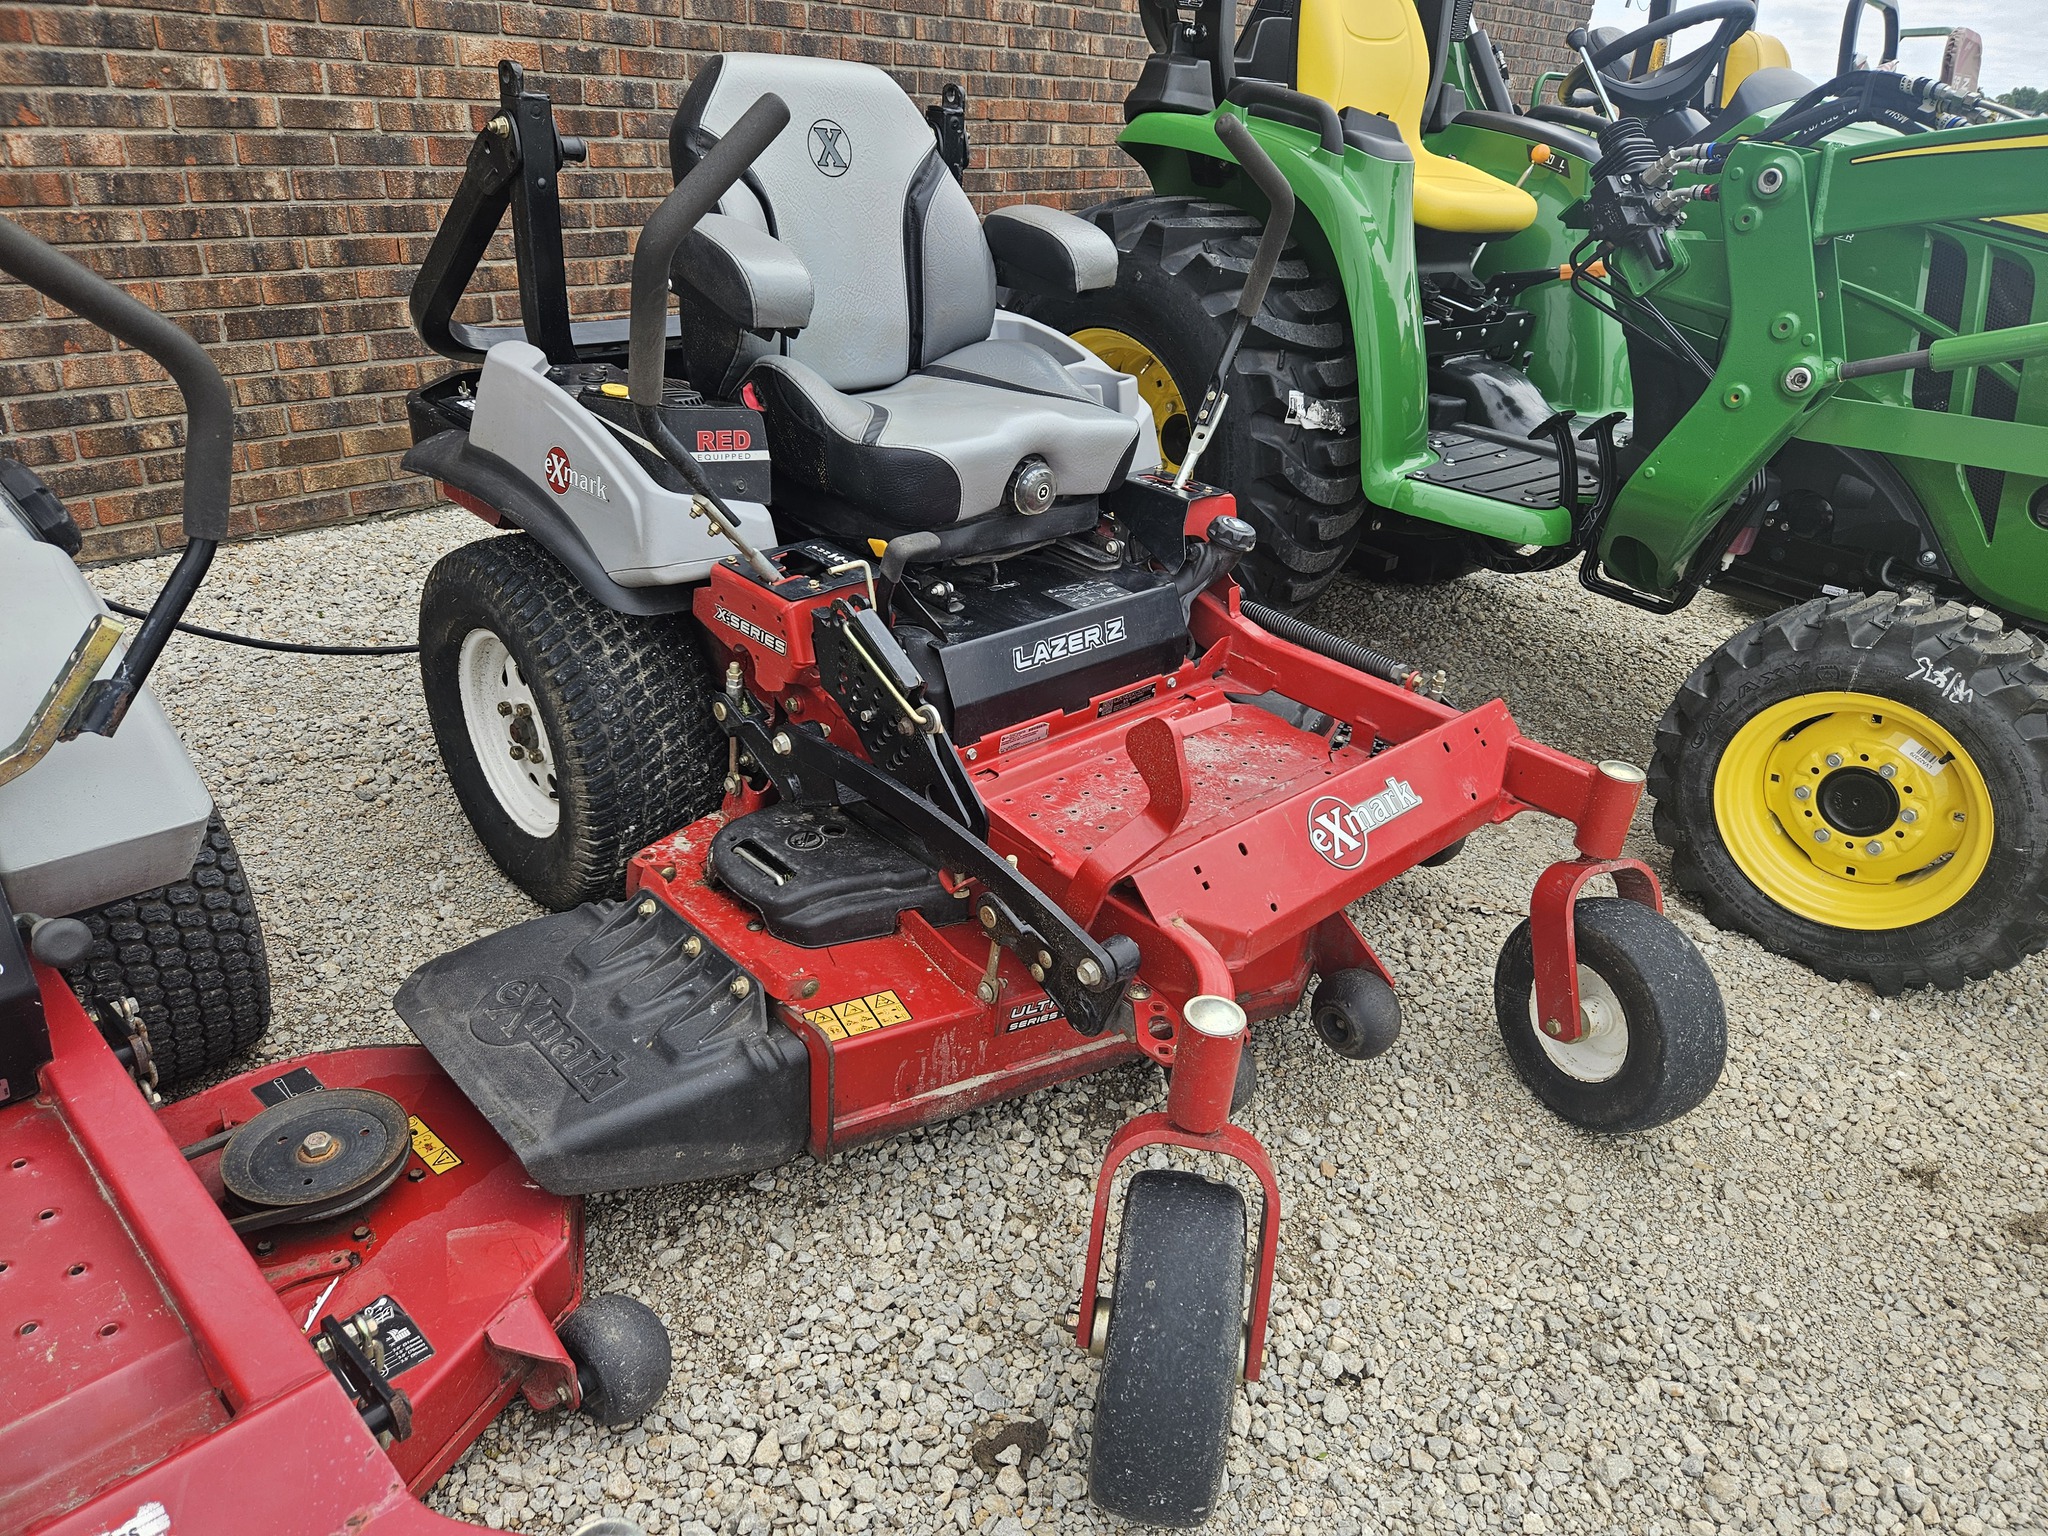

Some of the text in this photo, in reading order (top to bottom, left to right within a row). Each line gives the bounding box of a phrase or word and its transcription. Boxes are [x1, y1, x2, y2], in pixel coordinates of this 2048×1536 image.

[696, 430, 751, 451] RED
[697, 452, 752, 462] EQUIPPED
[713, 604, 788, 657] X-SERIES
[1013, 616, 1127, 673] LAZER Z
[1689, 659, 1812, 751] GALAXY
[1310, 777, 1420, 863] eXmark
[1008, 1011, 1059, 1031] SERIES
